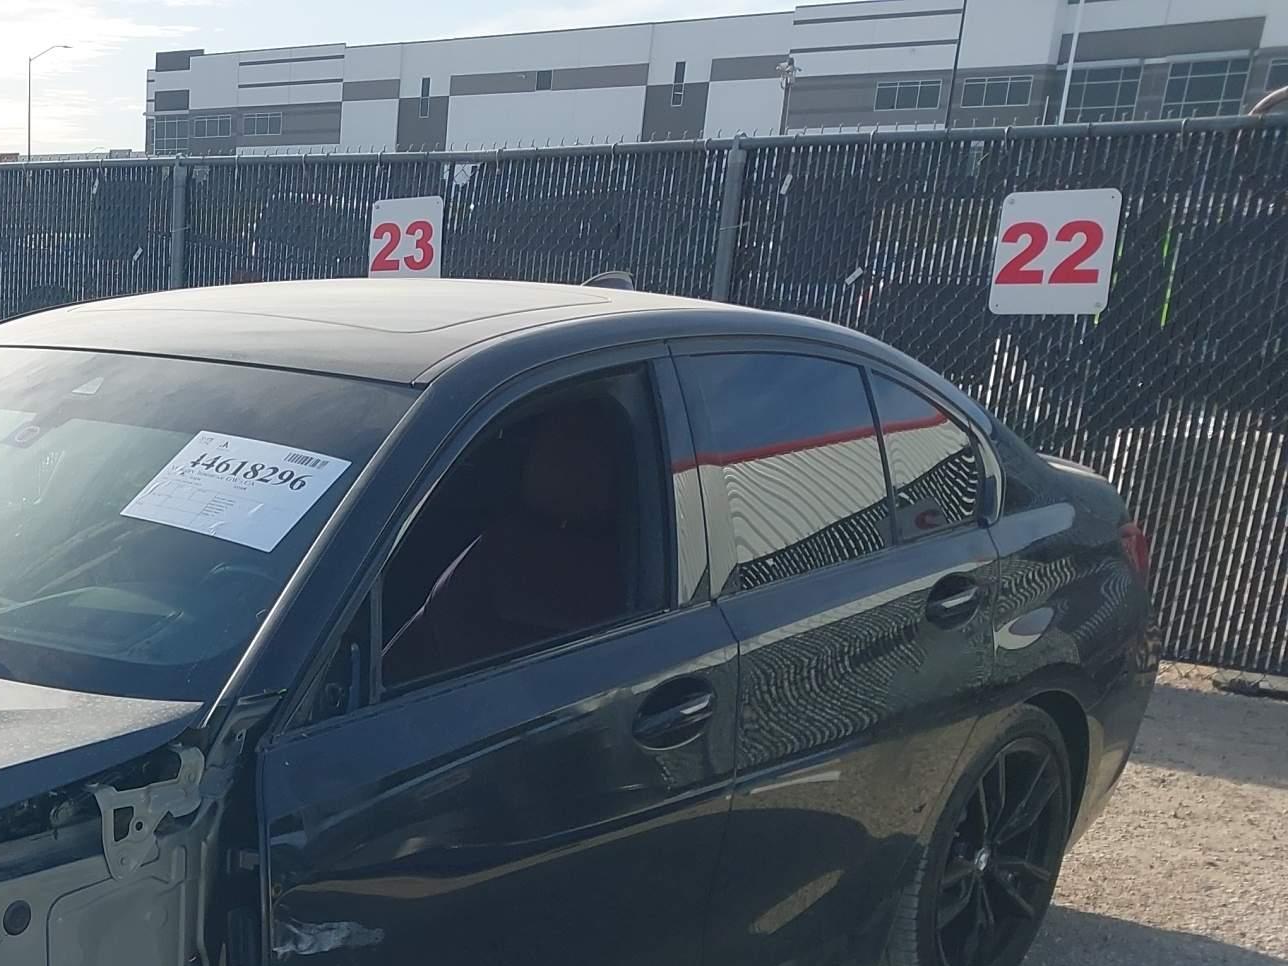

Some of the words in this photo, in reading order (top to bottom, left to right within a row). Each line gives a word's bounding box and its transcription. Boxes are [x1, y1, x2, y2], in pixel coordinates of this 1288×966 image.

[370, 220, 434, 271] 23
[994, 220, 1104, 285] 22
[189, 452, 313, 492] 44618296
